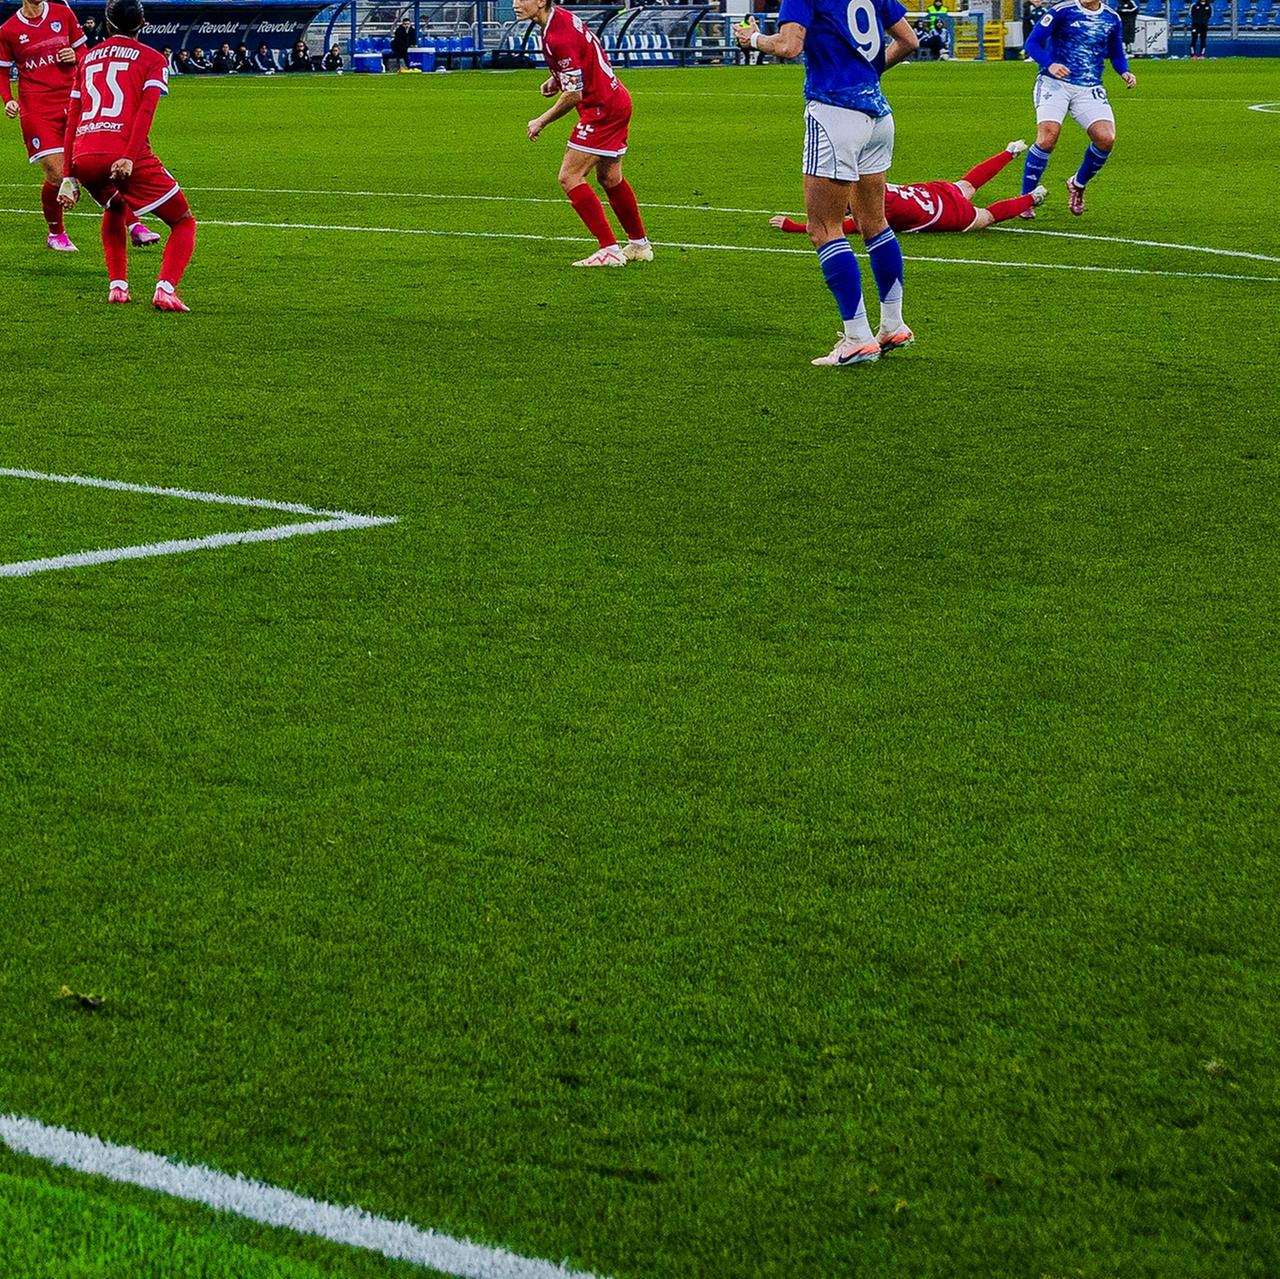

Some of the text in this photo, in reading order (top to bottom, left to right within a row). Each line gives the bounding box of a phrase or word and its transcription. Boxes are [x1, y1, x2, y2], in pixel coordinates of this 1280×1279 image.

[139, 21, 180, 34] Revolut
[198, 21, 239, 34] Revolut
[257, 21, 297, 33] Revolut
[109, 45, 140, 61] PINDO
[82, 61, 130, 121] 55
